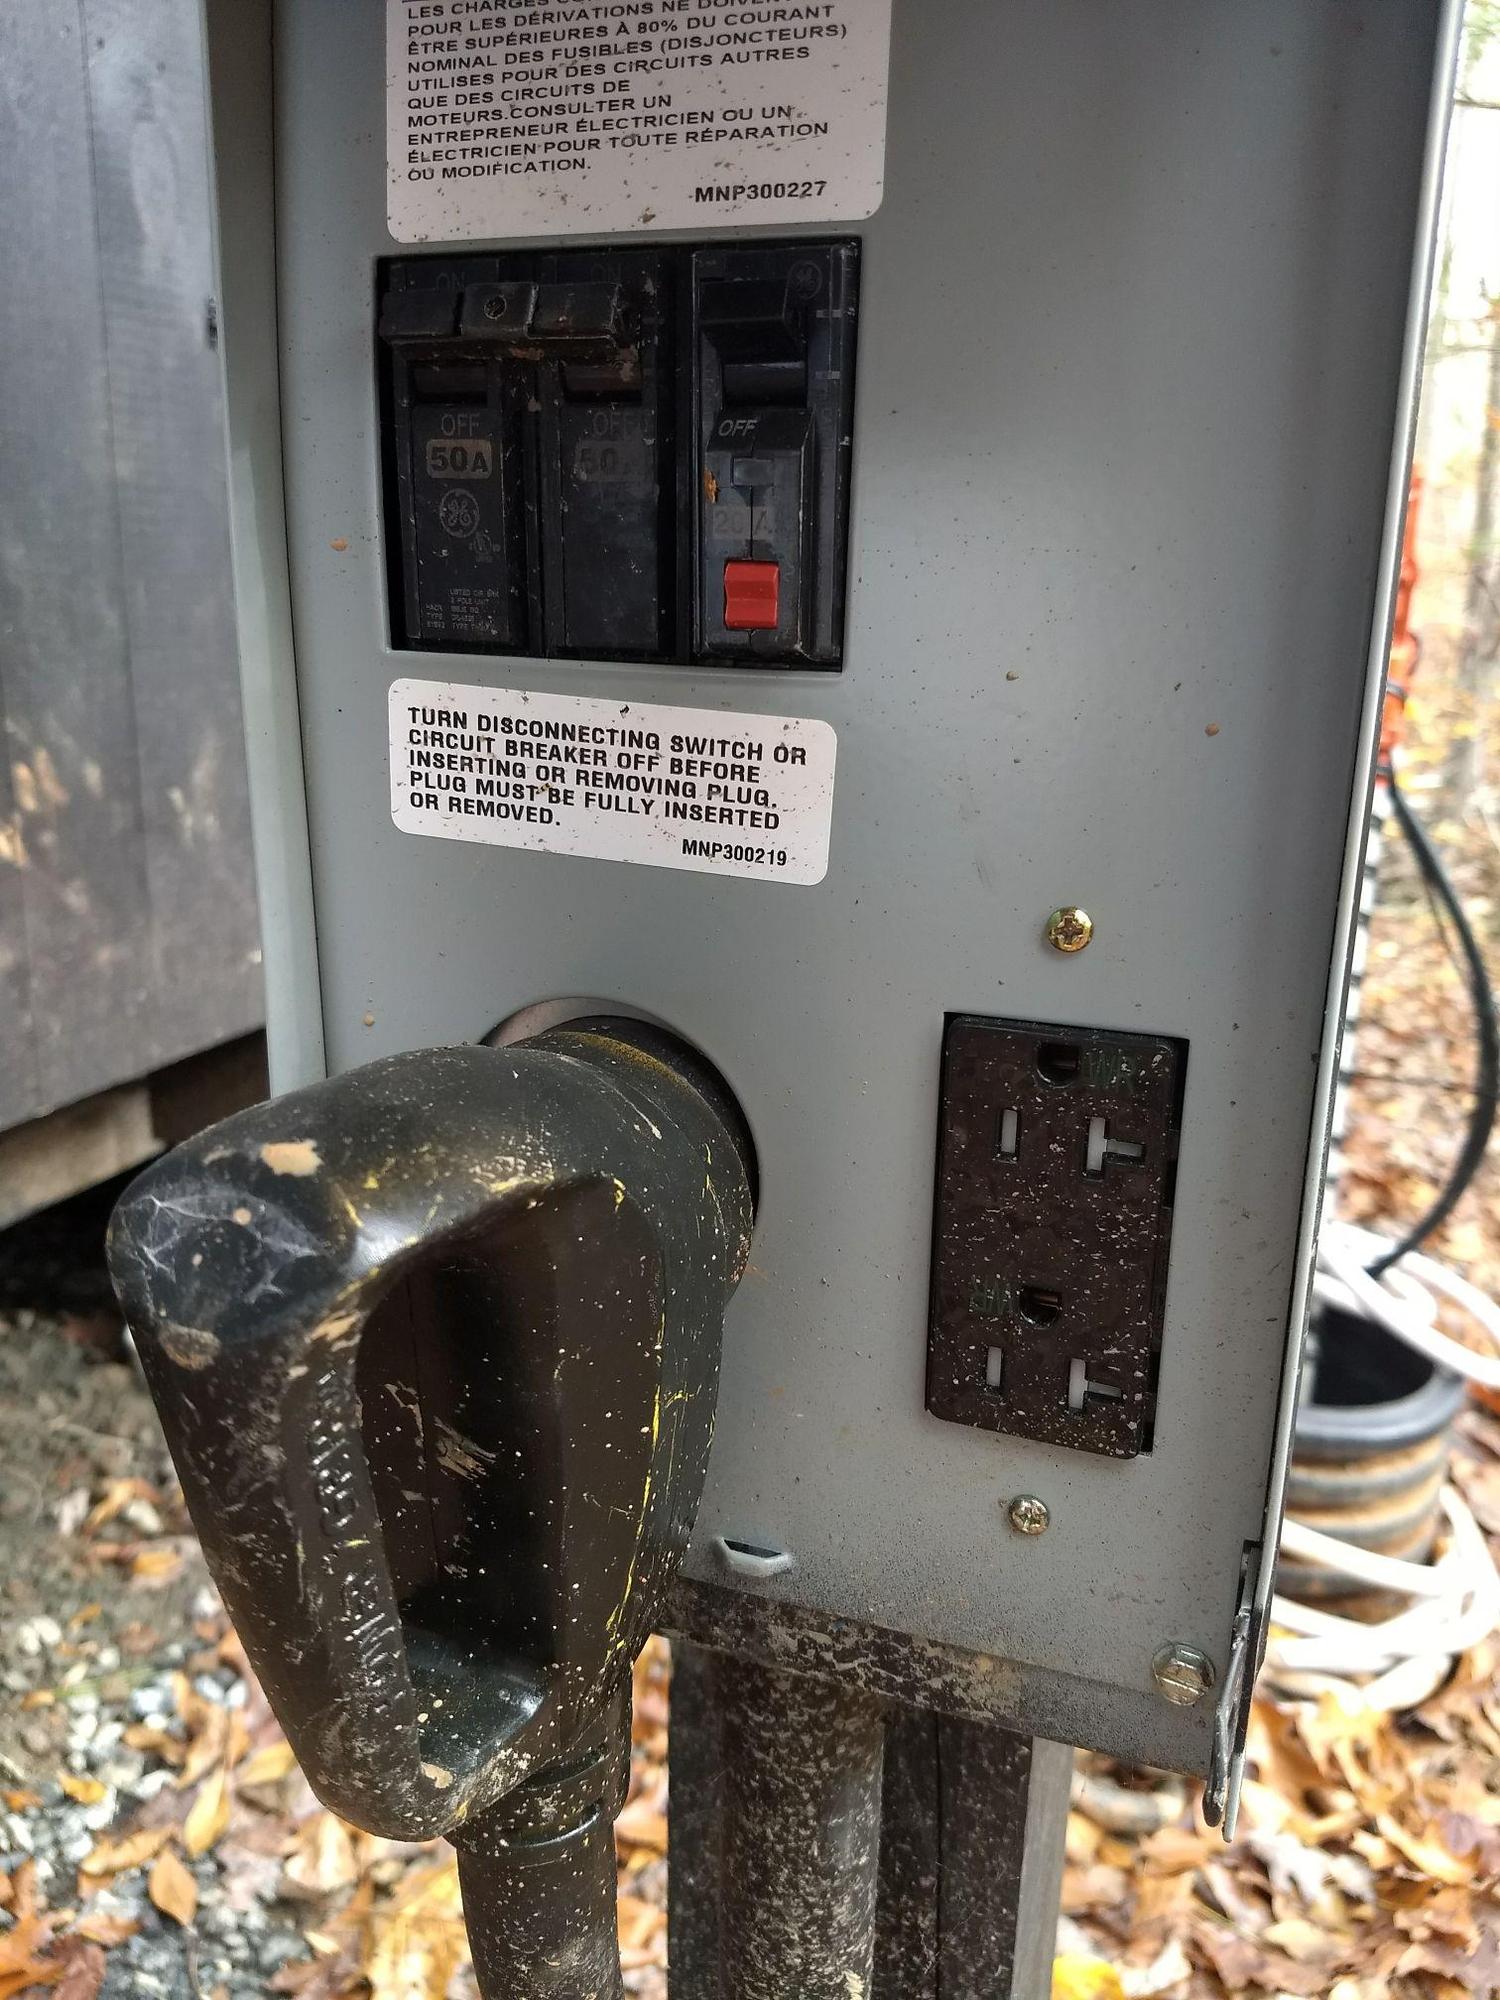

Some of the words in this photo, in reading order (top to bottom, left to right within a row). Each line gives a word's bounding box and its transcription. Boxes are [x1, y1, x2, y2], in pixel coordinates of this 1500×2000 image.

[408, 5, 444, 19] LES
[408, 21, 462, 38] POUR
[469, 16, 506, 32] LES
[514, 2, 653, 27] DÉRIVATIONS
[662, 0, 689, 13] NE
[408, 40, 458, 56] ÊTRE
[465, 25, 608, 50] SUPÉRIEURES
[615, 21, 630, 36] À
[637, 19, 678, 34] 80%
[687, 15, 716, 30] DU
[724, 5, 834, 26] COURANT
[408, 55, 498, 74] NOMINAL
[505, 50, 544, 65] DES
[552, 40, 653, 61] FUSIBLES
[660, 24, 847, 55] (DISJONCTEURS)
[408, 73, 494, 91] UTILISES
[502, 67, 558, 84] POUR
[565, 59, 606, 78] DES
[613, 54, 712, 74] CIRCUITS
[720, 46, 809, 65] AUTRES
[407, 95, 448, 110] QUE
[455, 91, 494, 106] DES
[501, 83, 595, 102] CIRCUITS
[603, 79, 630, 93] DE
[643, 95, 671, 109] UN
[408, 122, 569, 146] ENTREPRENEUR
[576, 110, 714, 133] ÉLECTRICIEN
[722, 108, 753, 122] OU
[762, 105, 790, 120] UN
[408, 143, 536, 164] ÉLECTRICIEN
[544, 138, 601, 154] POUR
[608, 133, 678, 149] TOUTE
[685, 122, 828, 143] RÉPARATION
[408, 167, 435, 181] OU
[442, 157, 591, 179] MODIFICATION.
[695, 180, 827, 203] MNP300227
[441, 412, 481, 436] OFF
[719, 419, 758, 436] OFF
[431, 446, 489, 473] 50A
[407, 707, 467, 730] TURN
[477, 714, 660, 751] DISCONNECTING
[670, 735, 763, 761] SWITCH
[773, 742, 806, 766] OR
[409, 729, 496, 755] CIRCUIT
[505, 739, 608, 767] BREAKER
[617, 751, 660, 772] OFF
[670, 757, 760, 784] BEFORE
[409, 749, 527, 779] INSERTING
[535, 765, 566, 784] OR
[576, 768, 696, 799] REMOVING
[707, 783, 777, 809] PLUG.
[410, 770, 466, 793] PLUG
[476, 778, 538, 801] MUST
[548, 786, 575, 806] BE
[585, 791, 655, 815] FULLY
[665, 800, 779, 830] INSERTED
[410, 792, 439, 811] OR
[448, 796, 560, 826] REMOVED.
[682, 838, 787, 866] MNP300219
